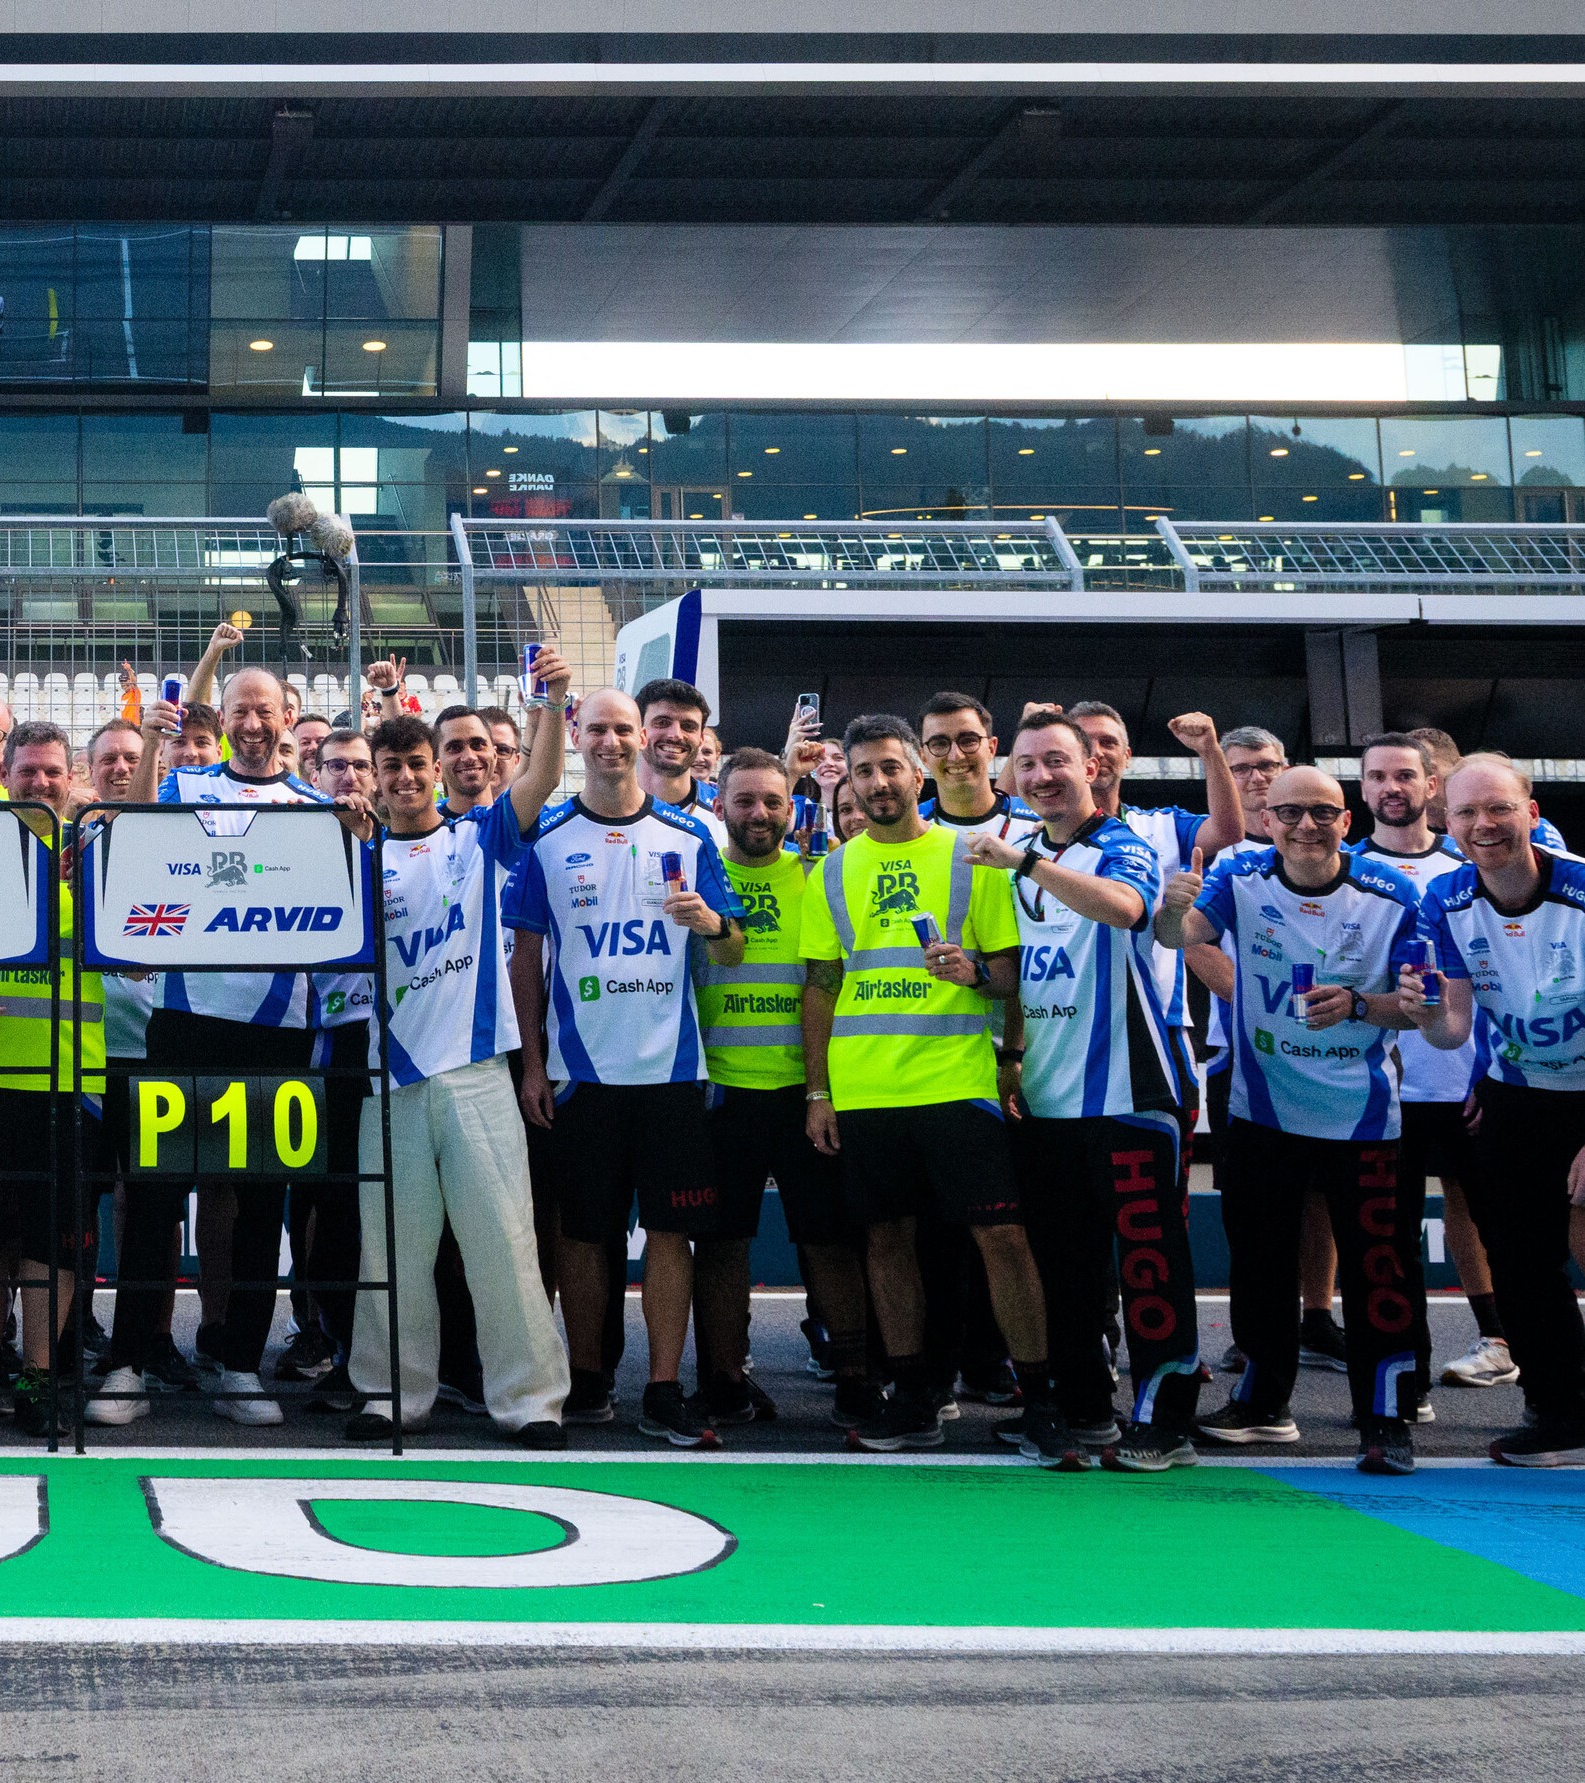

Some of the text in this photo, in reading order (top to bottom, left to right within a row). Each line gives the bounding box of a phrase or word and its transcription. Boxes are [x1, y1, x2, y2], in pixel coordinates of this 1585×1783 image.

[185, 766, 215, 777] HUO
[297, 783, 328, 800] HUGO
[662, 810, 695, 828] HUGO
[1119, 845, 1152, 863] VISA
[166, 863, 201, 876] VISA
[278, 865, 291, 873] App
[879, 860, 912, 872] VISA
[1242, 861, 1268, 873] HGO
[569, 884, 597, 894] TUDOR
[739, 882, 771, 893] VISA
[1562, 883, 1585, 902] HUG
[383, 896, 404, 906] UDOR
[570, 896, 598, 909] Mobil
[203, 906, 344, 932] ARVID
[1299, 907, 1325, 918] Red Bull
[1341, 922, 1361, 930] VISA
[575, 919, 671, 959] VISA
[1254, 932, 1283, 949] TUDOR
[1251, 943, 1283, 961] Mobil
[409, 954, 474, 991] Cash App
[606, 978, 674, 997] Cash App
[853, 978, 932, 1001] Airtasker
[350, 992, 374, 1005] Cas
[723, 994, 801, 1013] Airtasker
[1023, 1005, 1049, 1019] Cash
[1478, 1006, 1585, 1047] VISA
[1280, 1040, 1360, 1060] Cash App
[138, 1080, 319, 1169] P10
[670, 1187, 717, 1207] HUG
[1111, 1150, 1177, 1341] HUGO
[1358, 1149, 1413, 1333] HUGO
